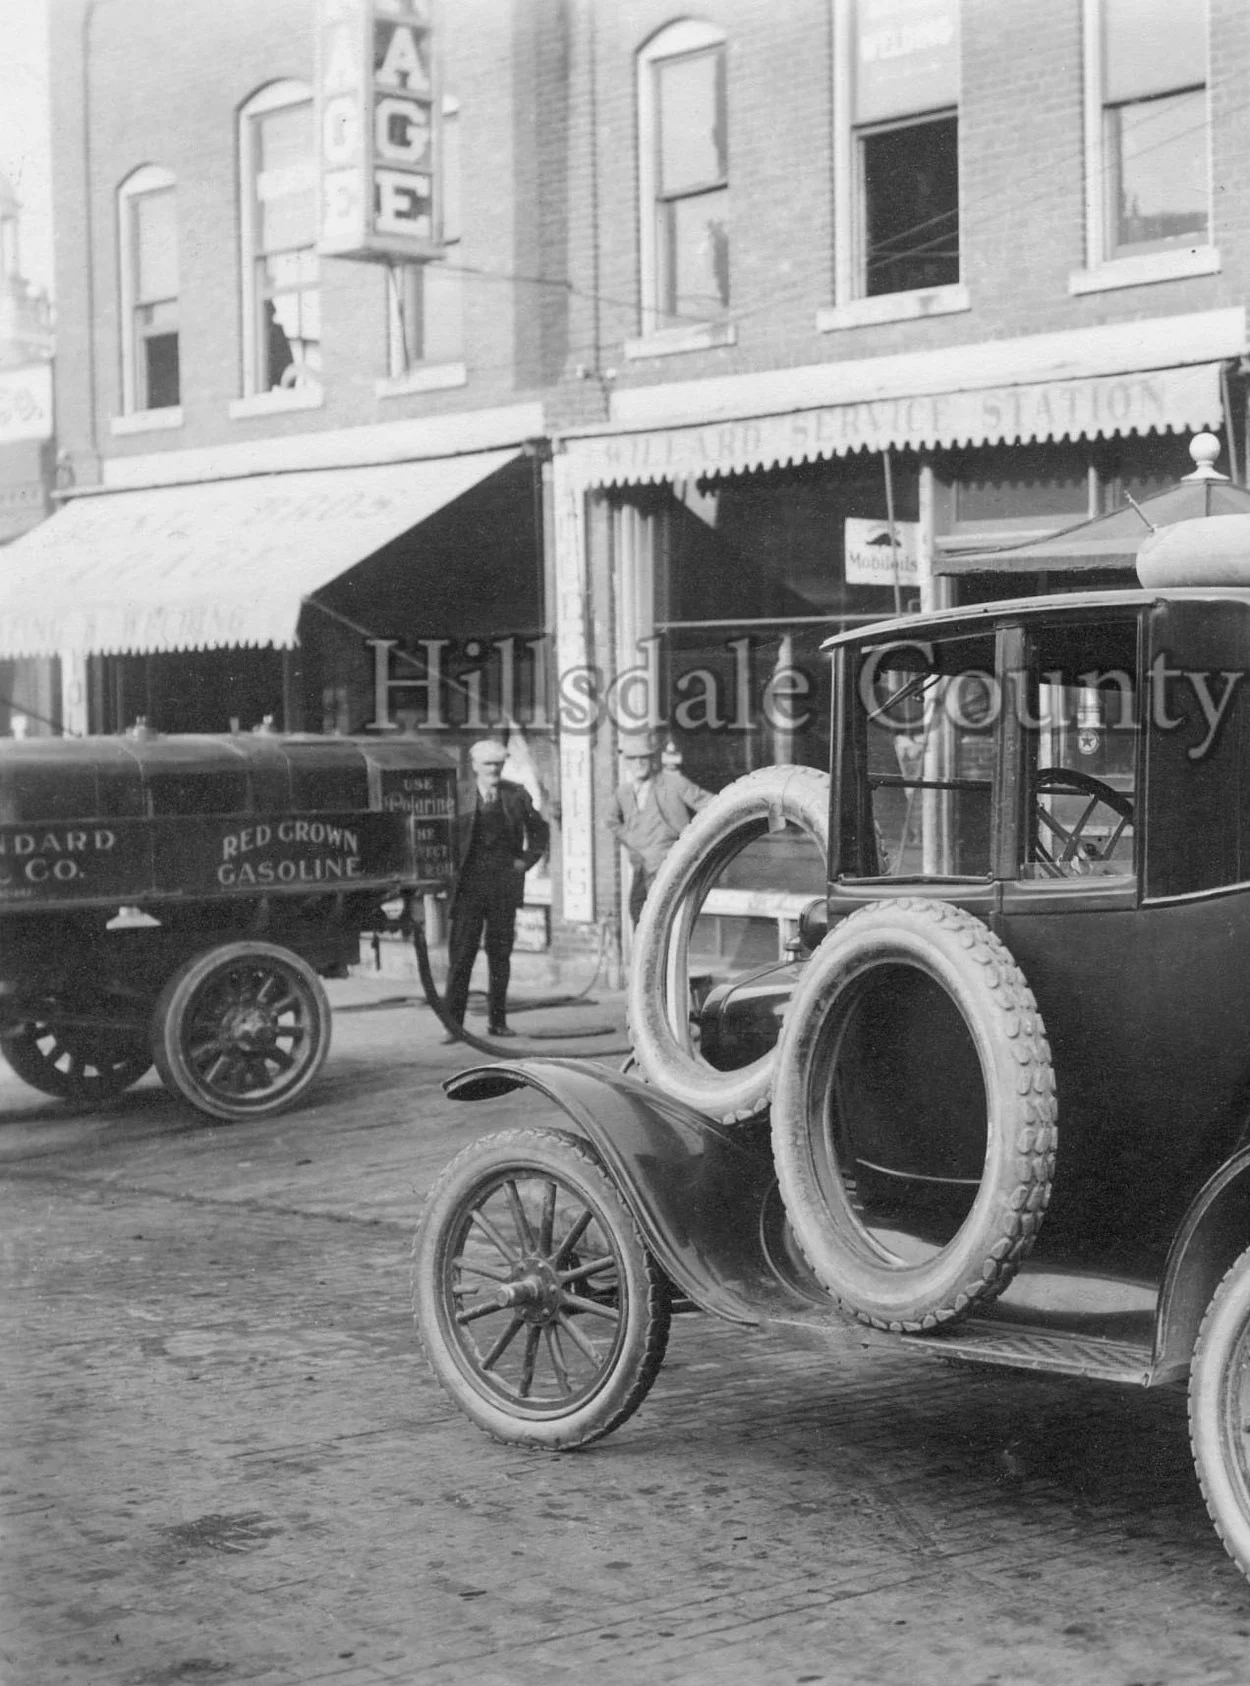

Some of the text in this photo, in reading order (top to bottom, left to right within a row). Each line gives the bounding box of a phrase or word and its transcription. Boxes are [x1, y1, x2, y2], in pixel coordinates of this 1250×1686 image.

[323, 0, 366, 237] AGE
[374, 0, 431, 237] AGE
[791, 396, 948, 443] SERVICE
[982, 379, 1167, 432] STATION
[0, 830, 116, 855] DARD
[223, 825, 272, 861] RED
[25, 858, 86, 882] CO.
[217, 856, 360, 885] GASOLINE
